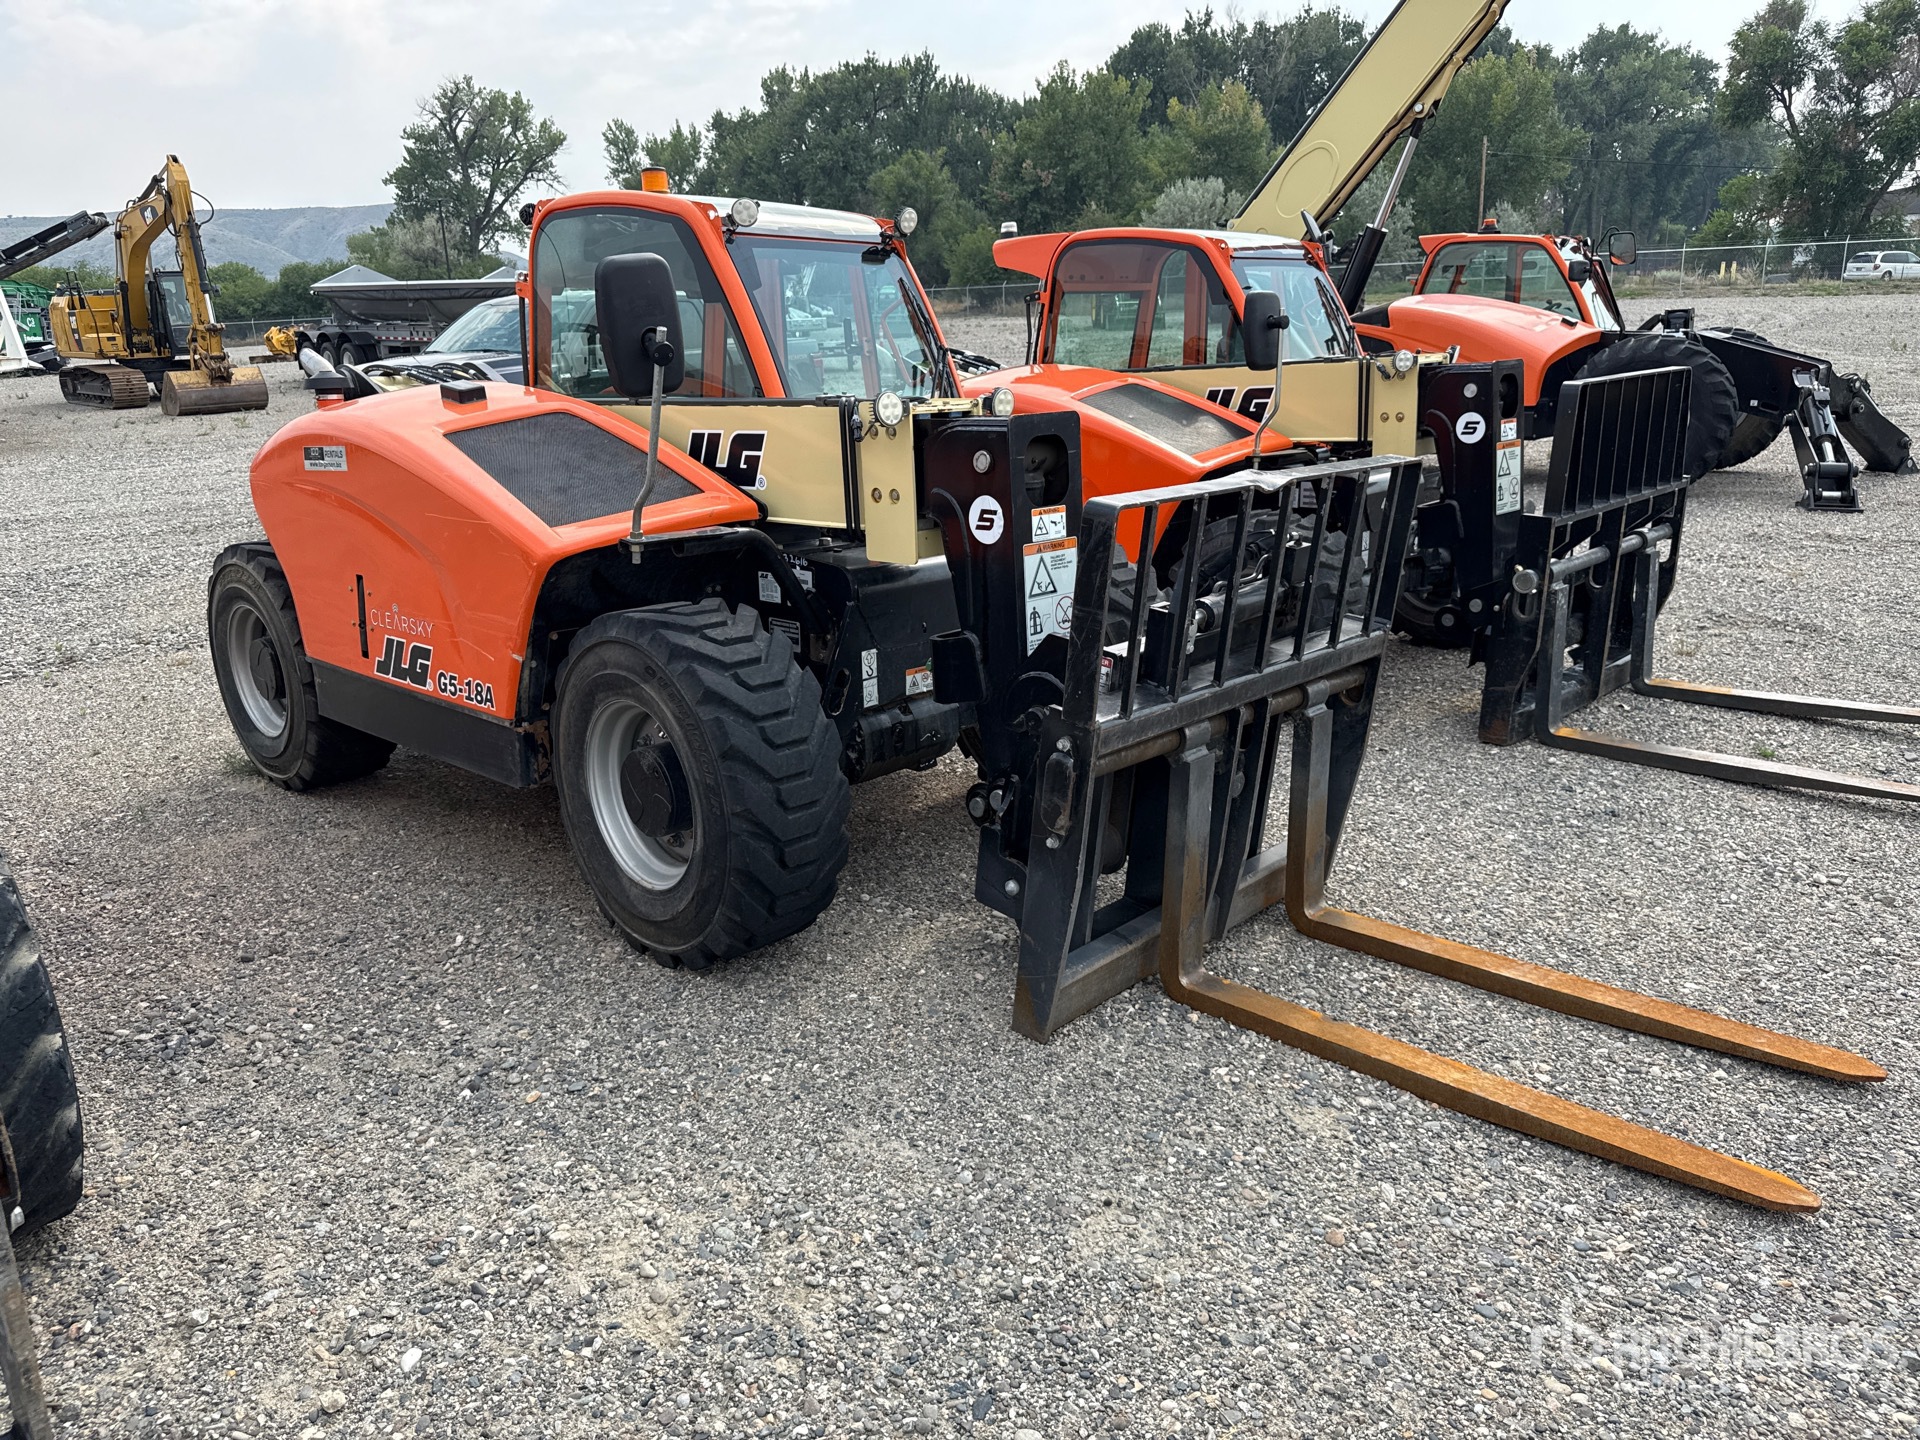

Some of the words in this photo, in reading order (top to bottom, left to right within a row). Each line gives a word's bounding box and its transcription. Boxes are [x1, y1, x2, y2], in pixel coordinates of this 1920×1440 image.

[370, 608, 434, 638] CLEARSKY
[374, 634, 433, 690] JLG
[437, 669, 496, 711] G5-18A
